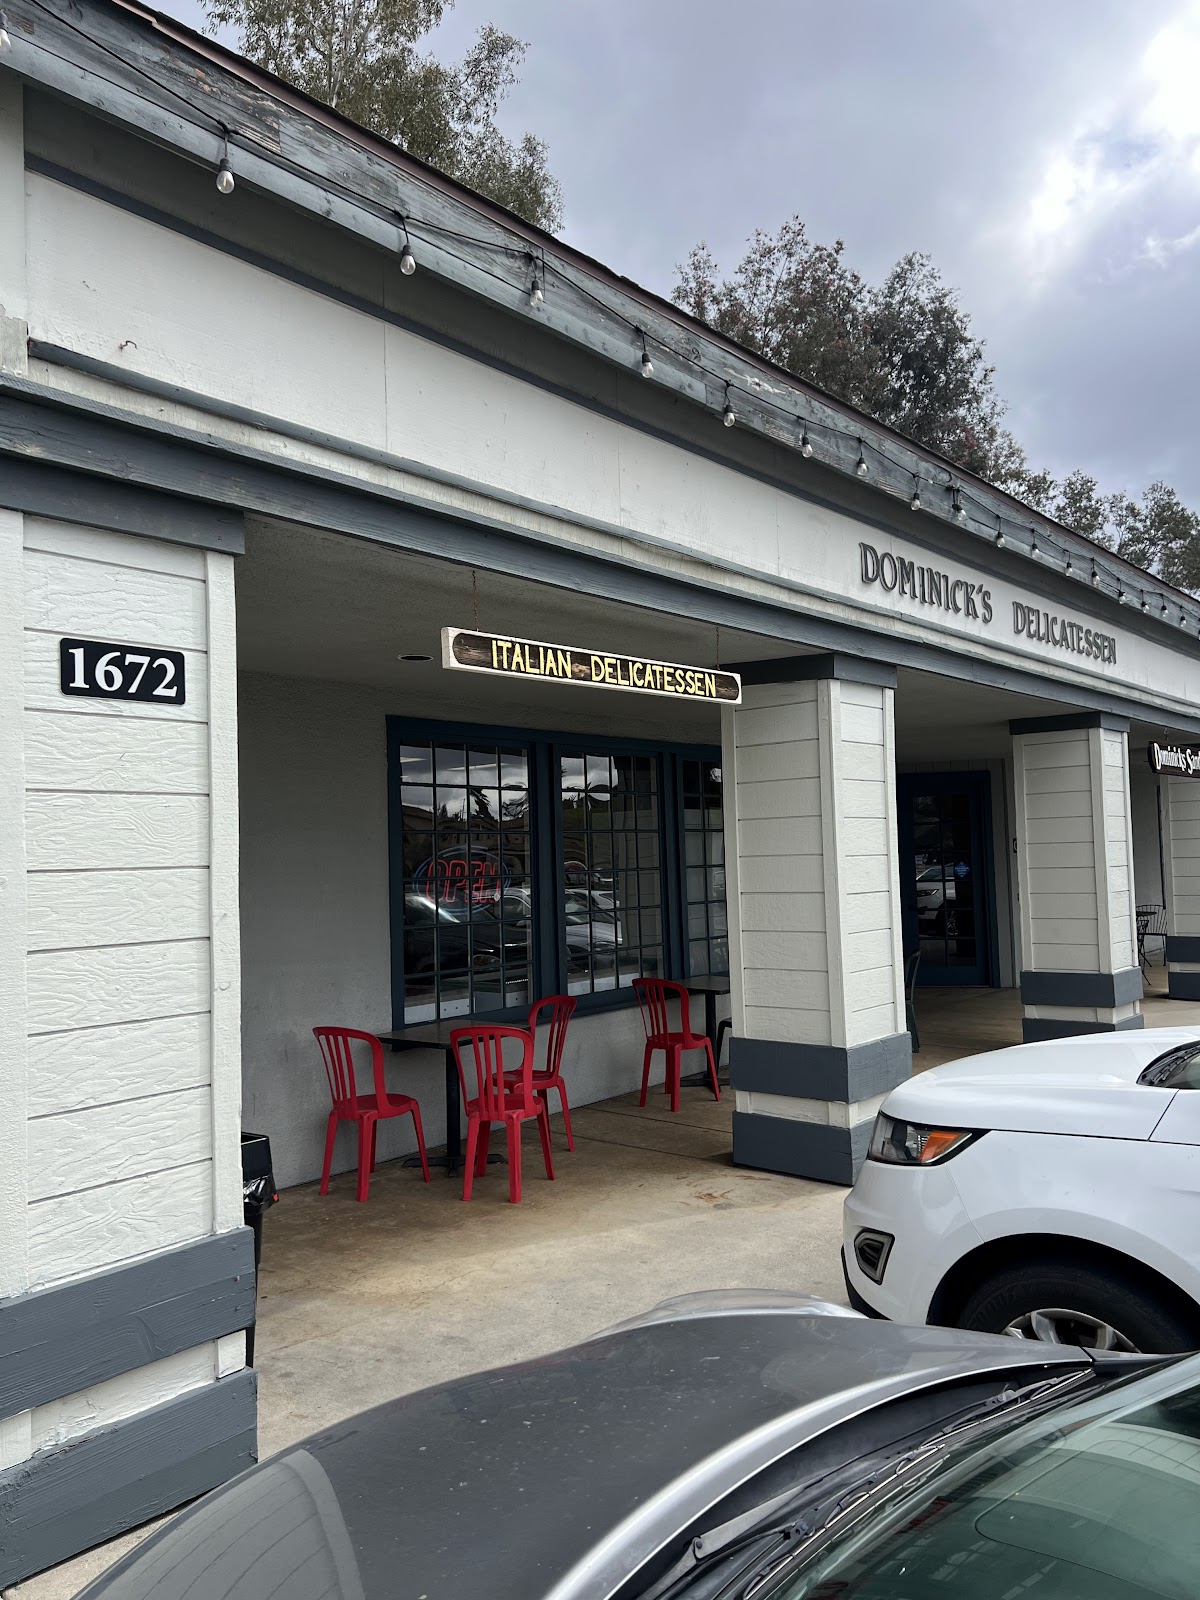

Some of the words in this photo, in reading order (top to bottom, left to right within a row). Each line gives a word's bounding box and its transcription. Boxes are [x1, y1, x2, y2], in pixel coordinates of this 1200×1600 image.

[859, 541, 993, 623] DOMINICK'S
[1012, 601, 1117, 664] DELICATESSEN
[68, 647, 178, 697] 1672
[491, 640, 572, 679] ITALIAN
[590, 655, 717, 697] DELICATESSEN
[426, 859, 501, 903] OPEN
